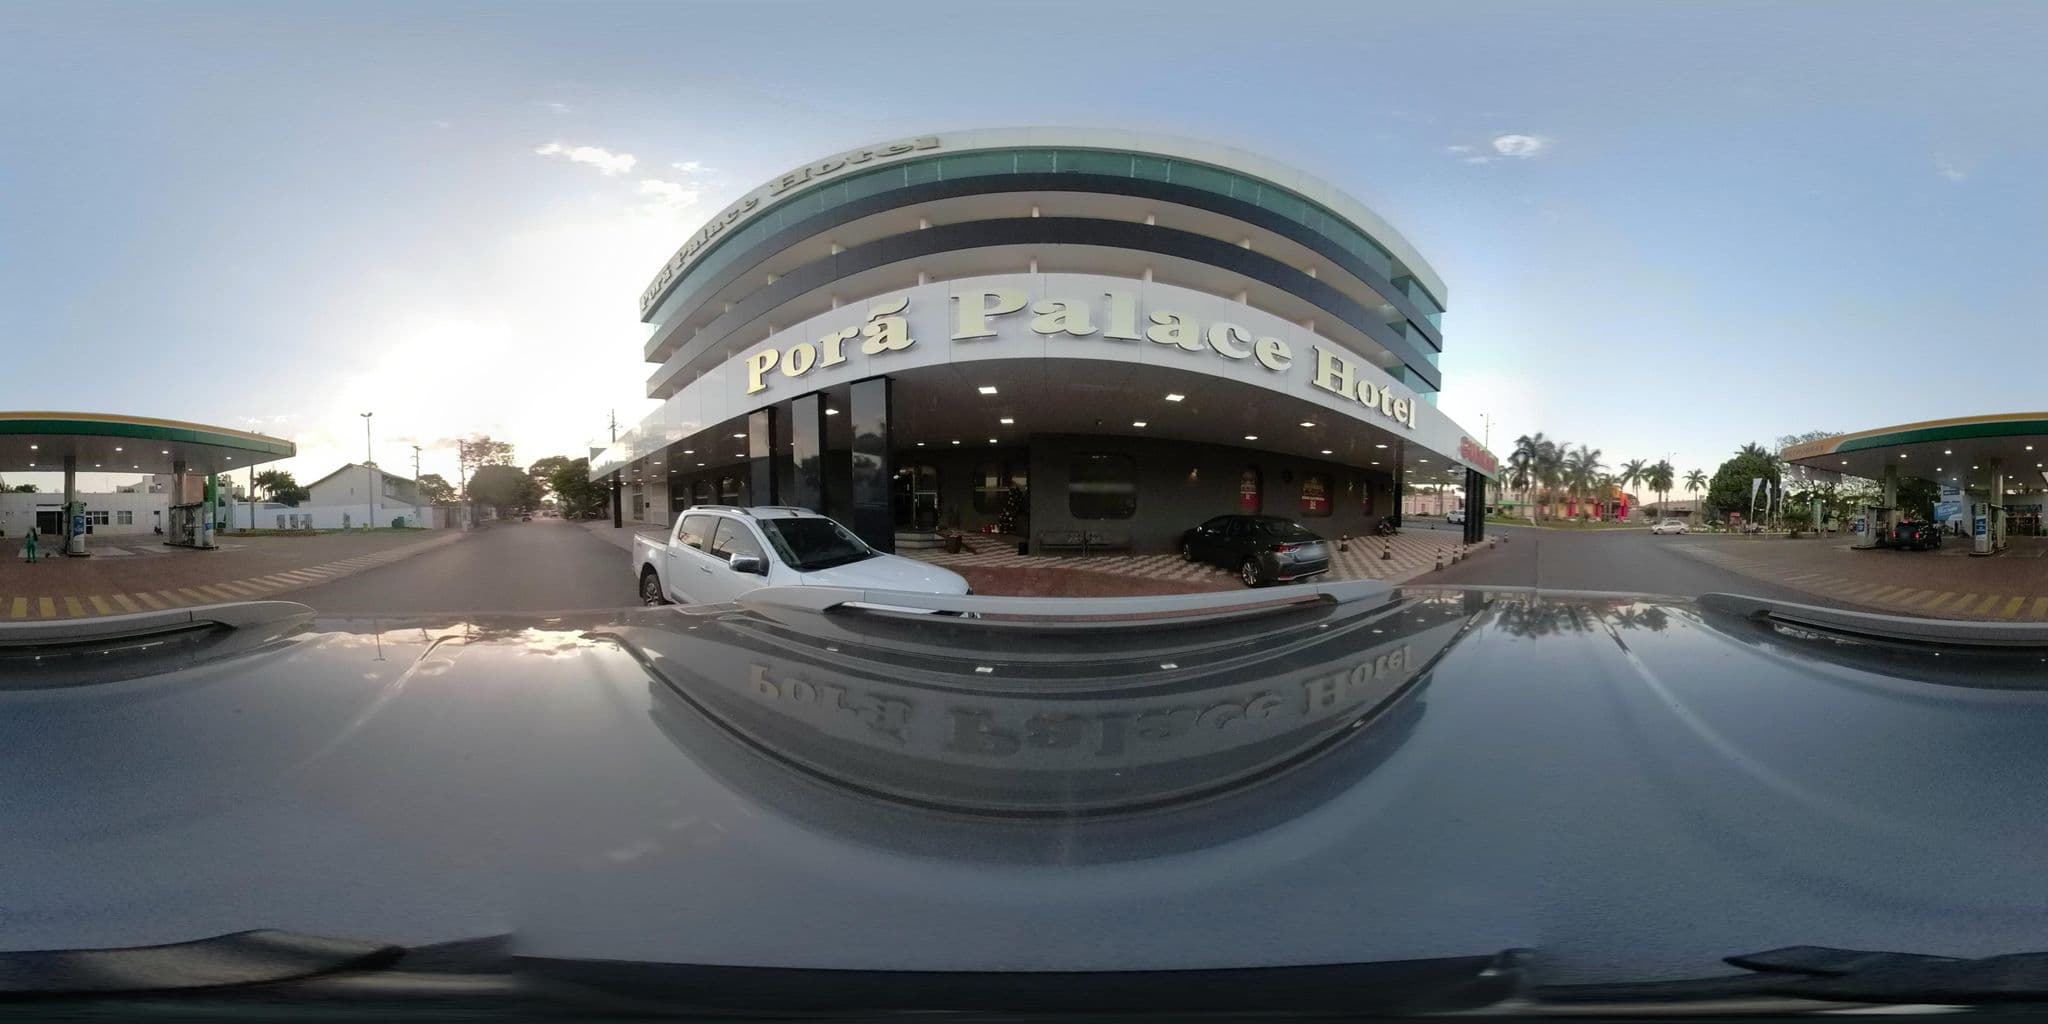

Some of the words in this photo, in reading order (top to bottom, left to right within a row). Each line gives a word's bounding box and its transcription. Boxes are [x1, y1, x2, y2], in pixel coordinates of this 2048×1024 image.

[676, 196, 759, 270] Palace
[770, 135, 941, 197] Hotel
[745, 296, 915, 394] Porã
[950, 290, 1295, 372] Palace
[1311, 344, 1417, 430] Hotel
